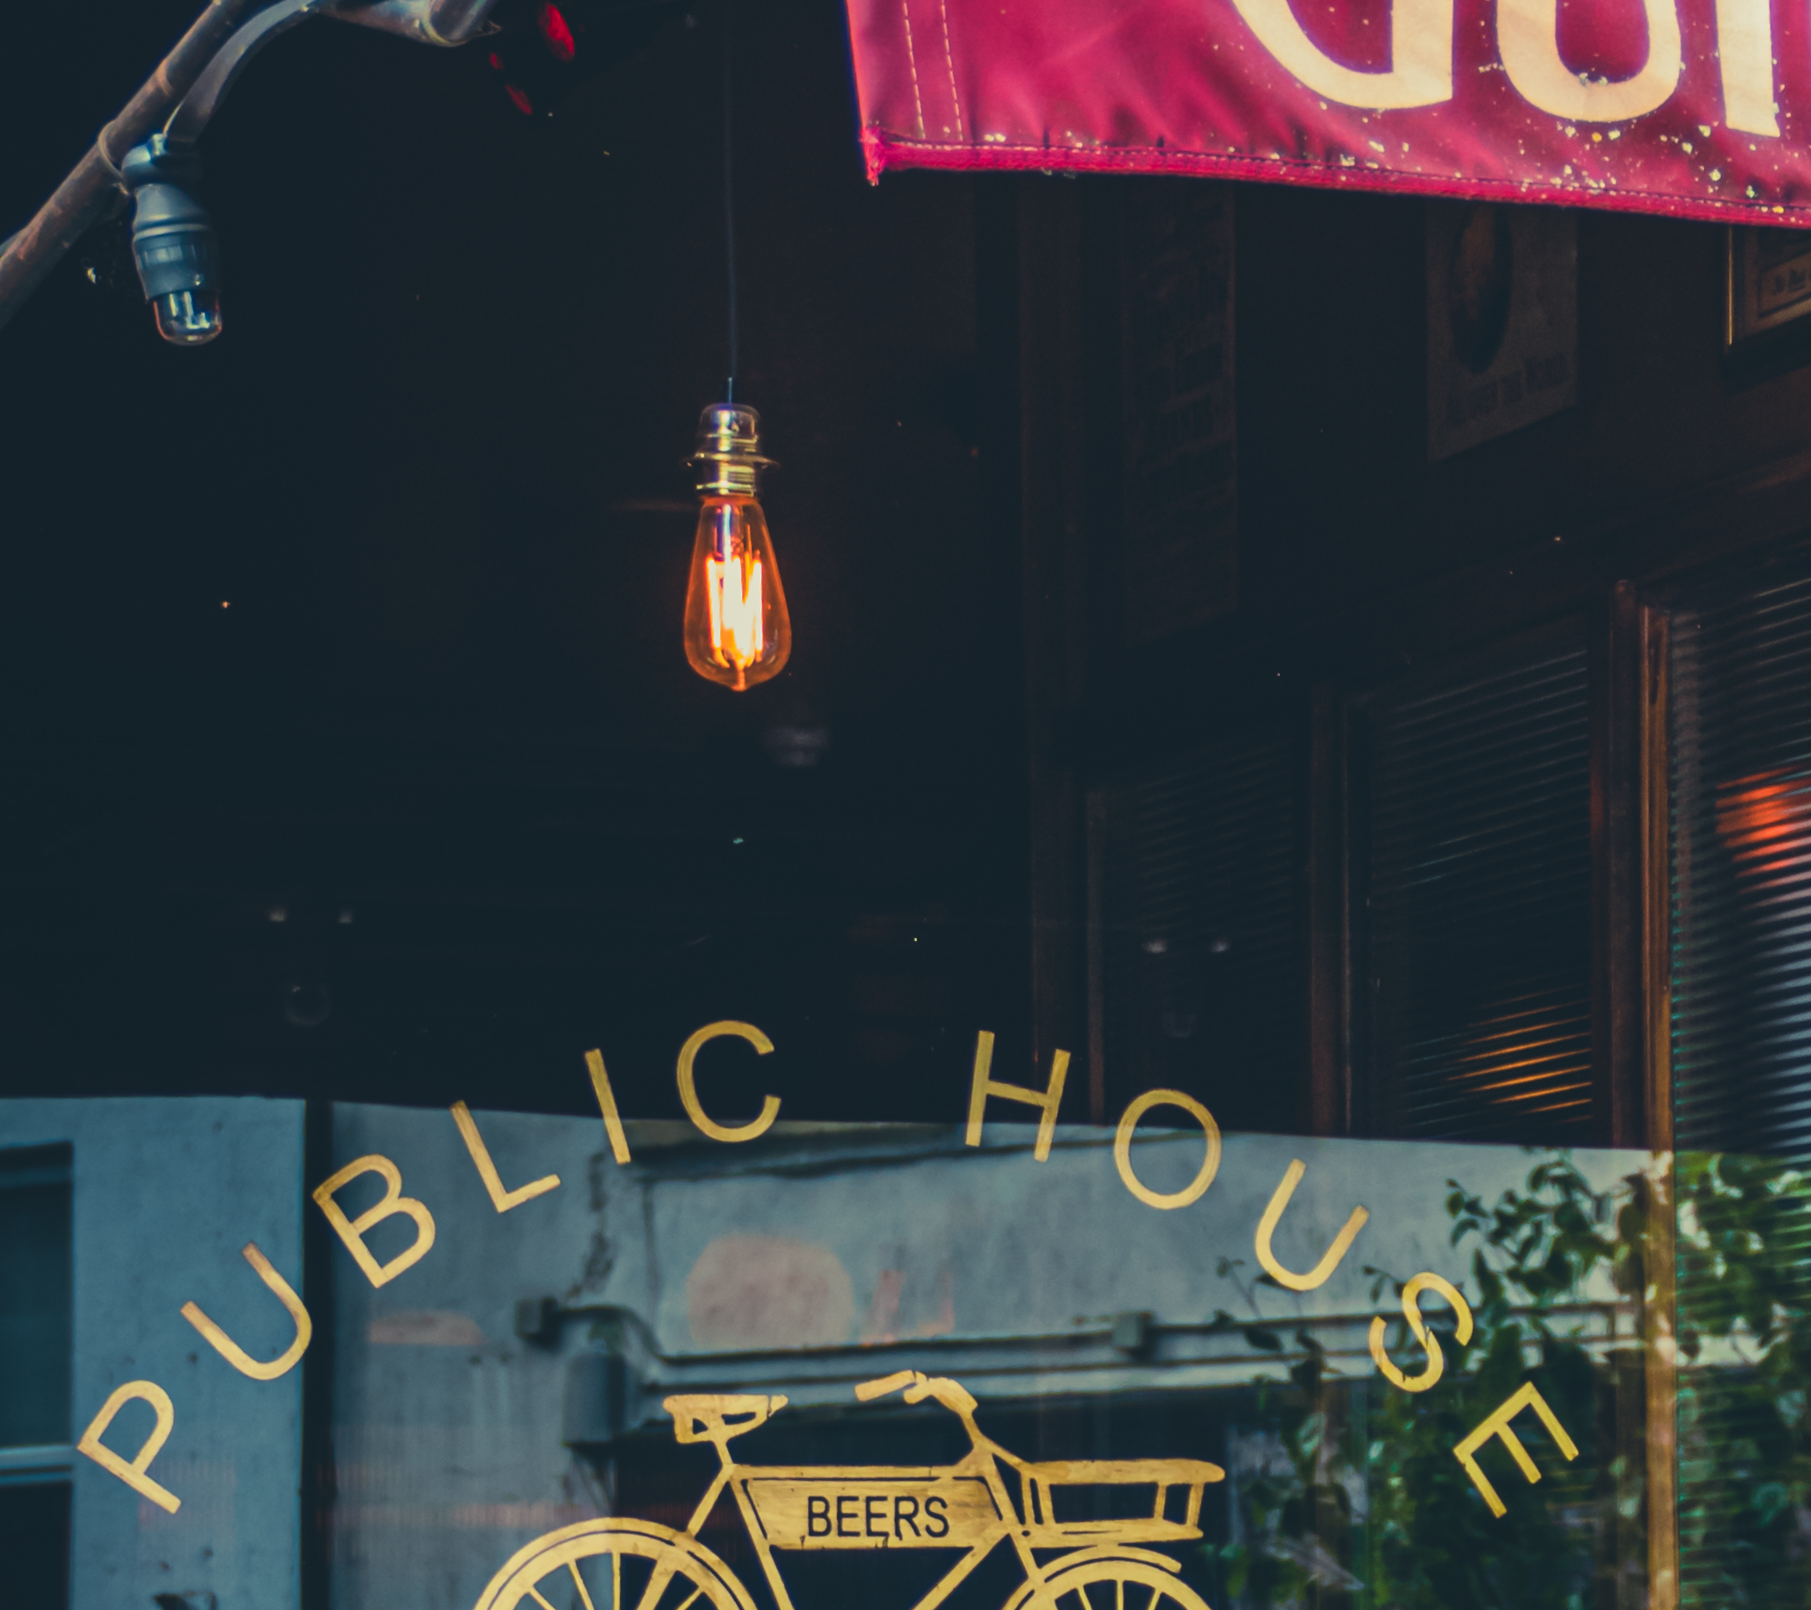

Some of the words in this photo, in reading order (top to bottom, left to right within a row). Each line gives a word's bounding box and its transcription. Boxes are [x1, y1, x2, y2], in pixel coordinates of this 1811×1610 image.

[77, 1019, 782, 1514] PUBLIC
[965, 1030, 1580, 1519] HOUSE
[808, 1495, 949, 1540] BEERS
